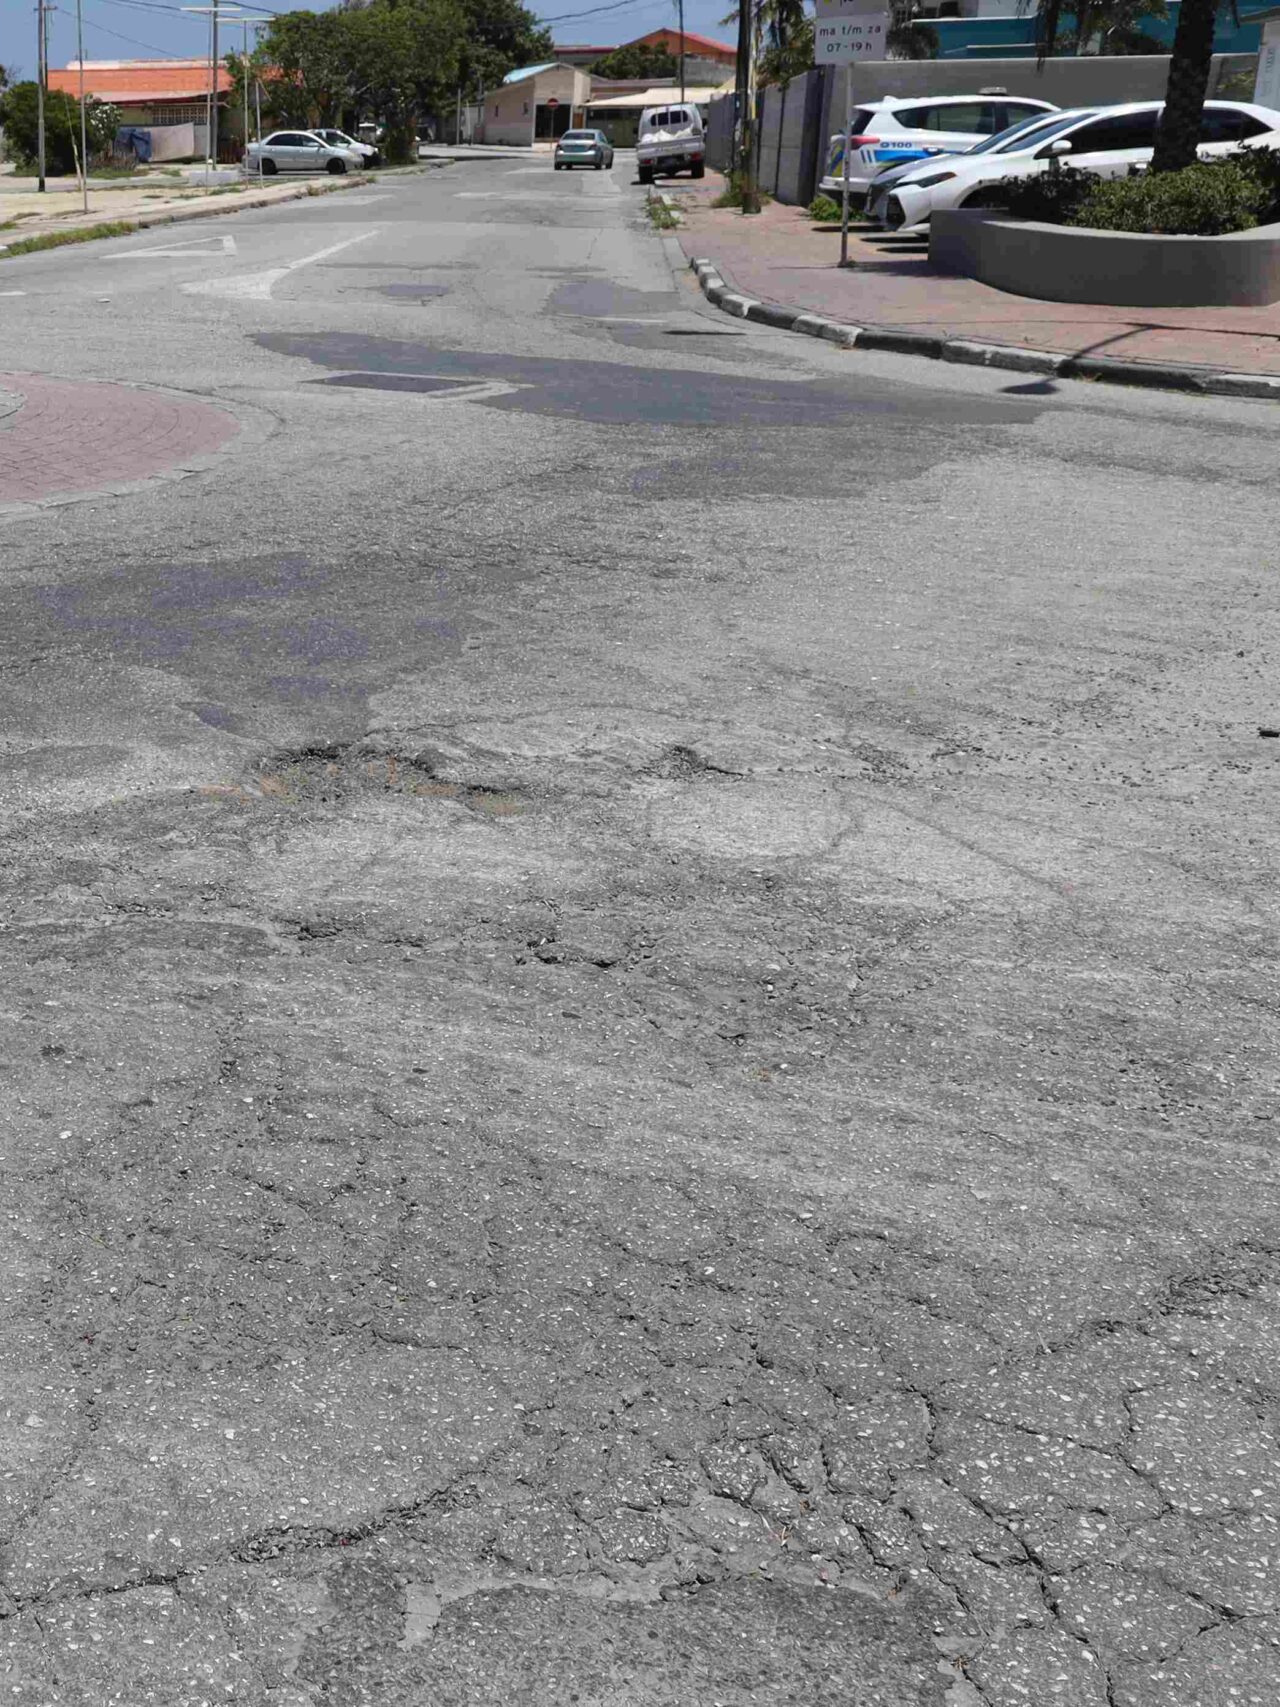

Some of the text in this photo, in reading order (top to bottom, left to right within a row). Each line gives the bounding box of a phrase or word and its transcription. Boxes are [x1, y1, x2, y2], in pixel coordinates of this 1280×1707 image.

[819, 25, 881, 36] ma t/m za
